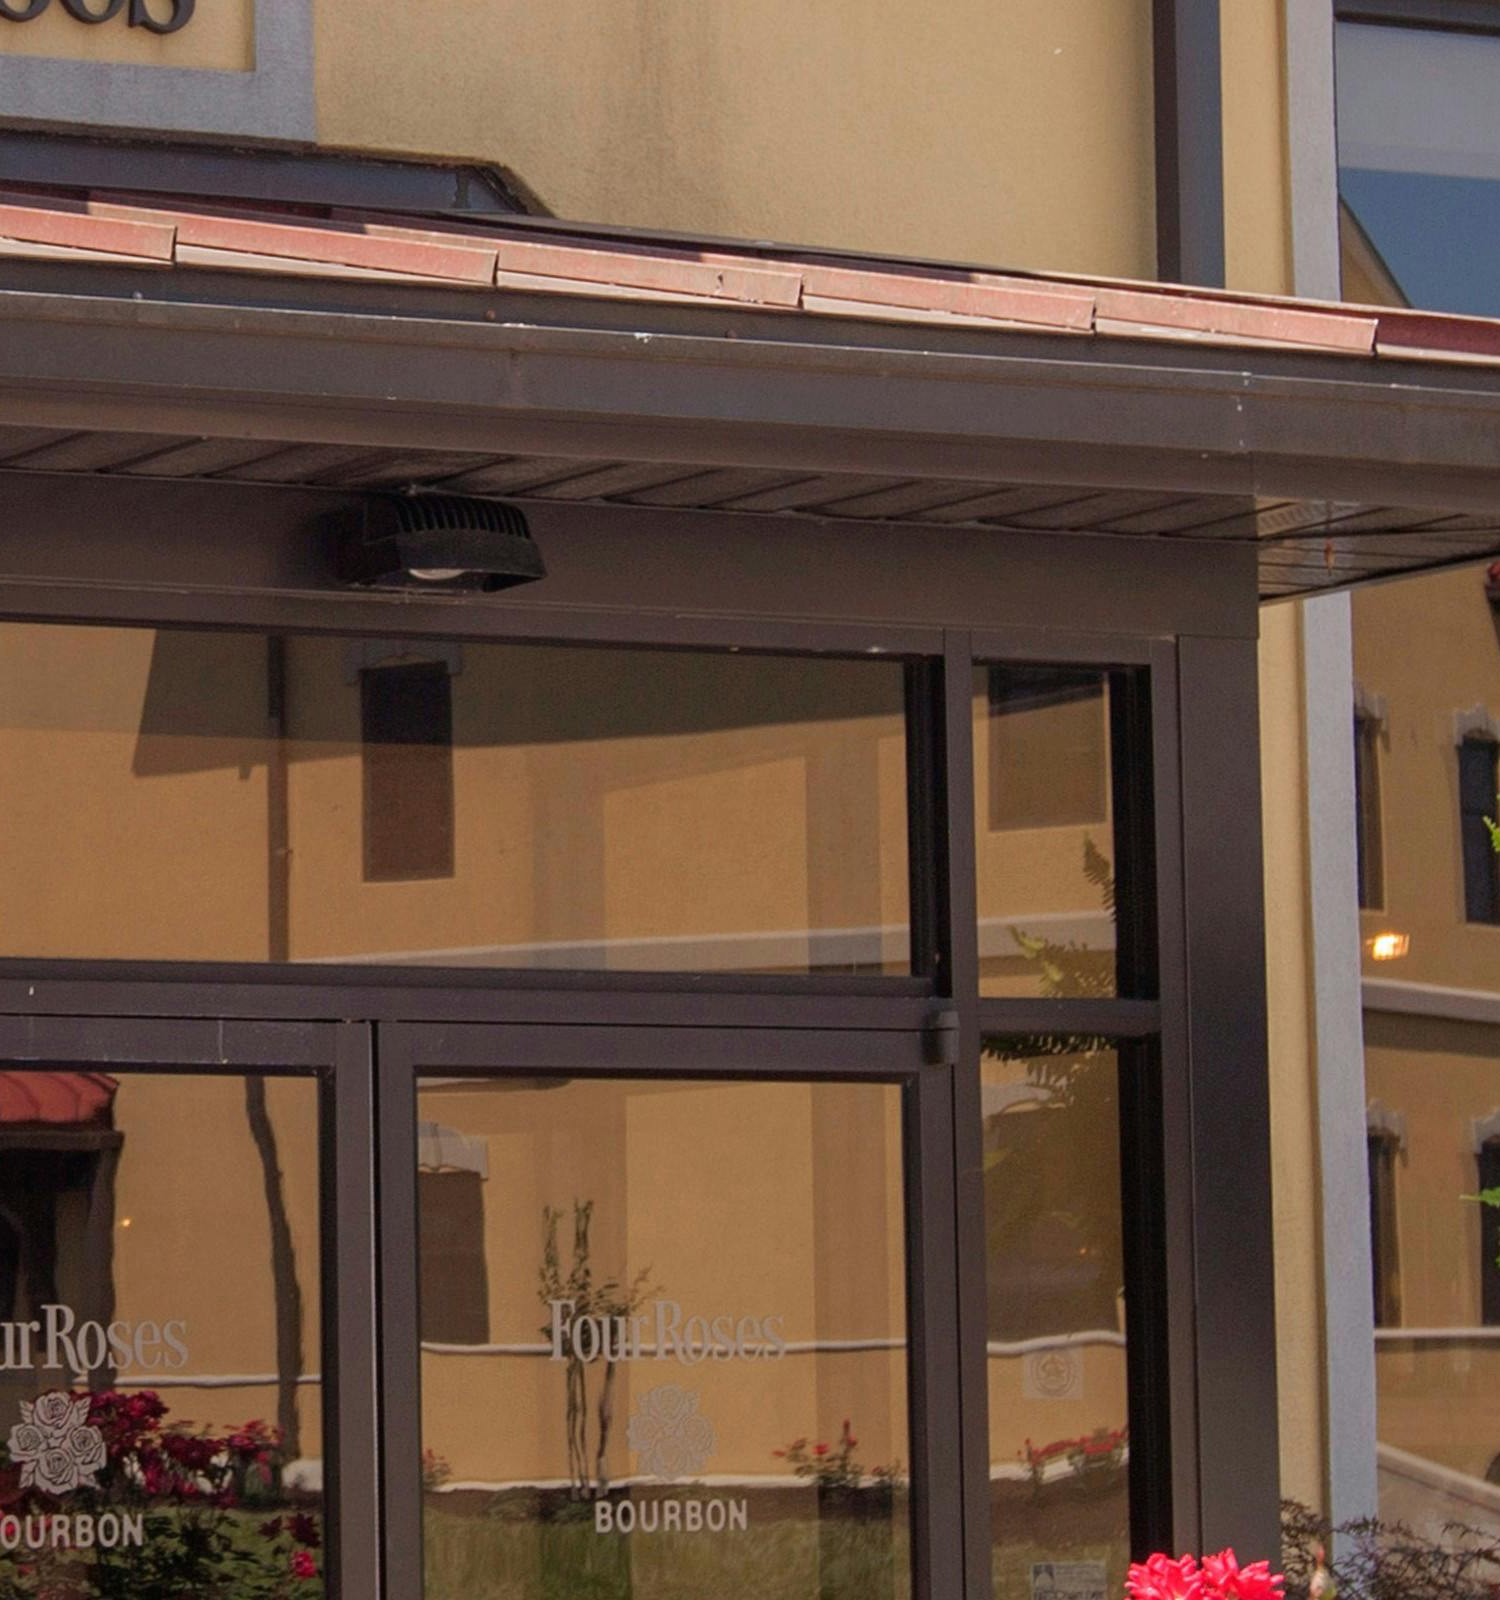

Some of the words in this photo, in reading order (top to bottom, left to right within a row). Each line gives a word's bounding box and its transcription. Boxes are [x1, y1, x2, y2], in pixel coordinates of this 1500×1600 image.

[40, 1303, 189, 1375] Roses
[549, 1299, 648, 1363] Four
[594, 1500, 748, 1534] BOURBON
